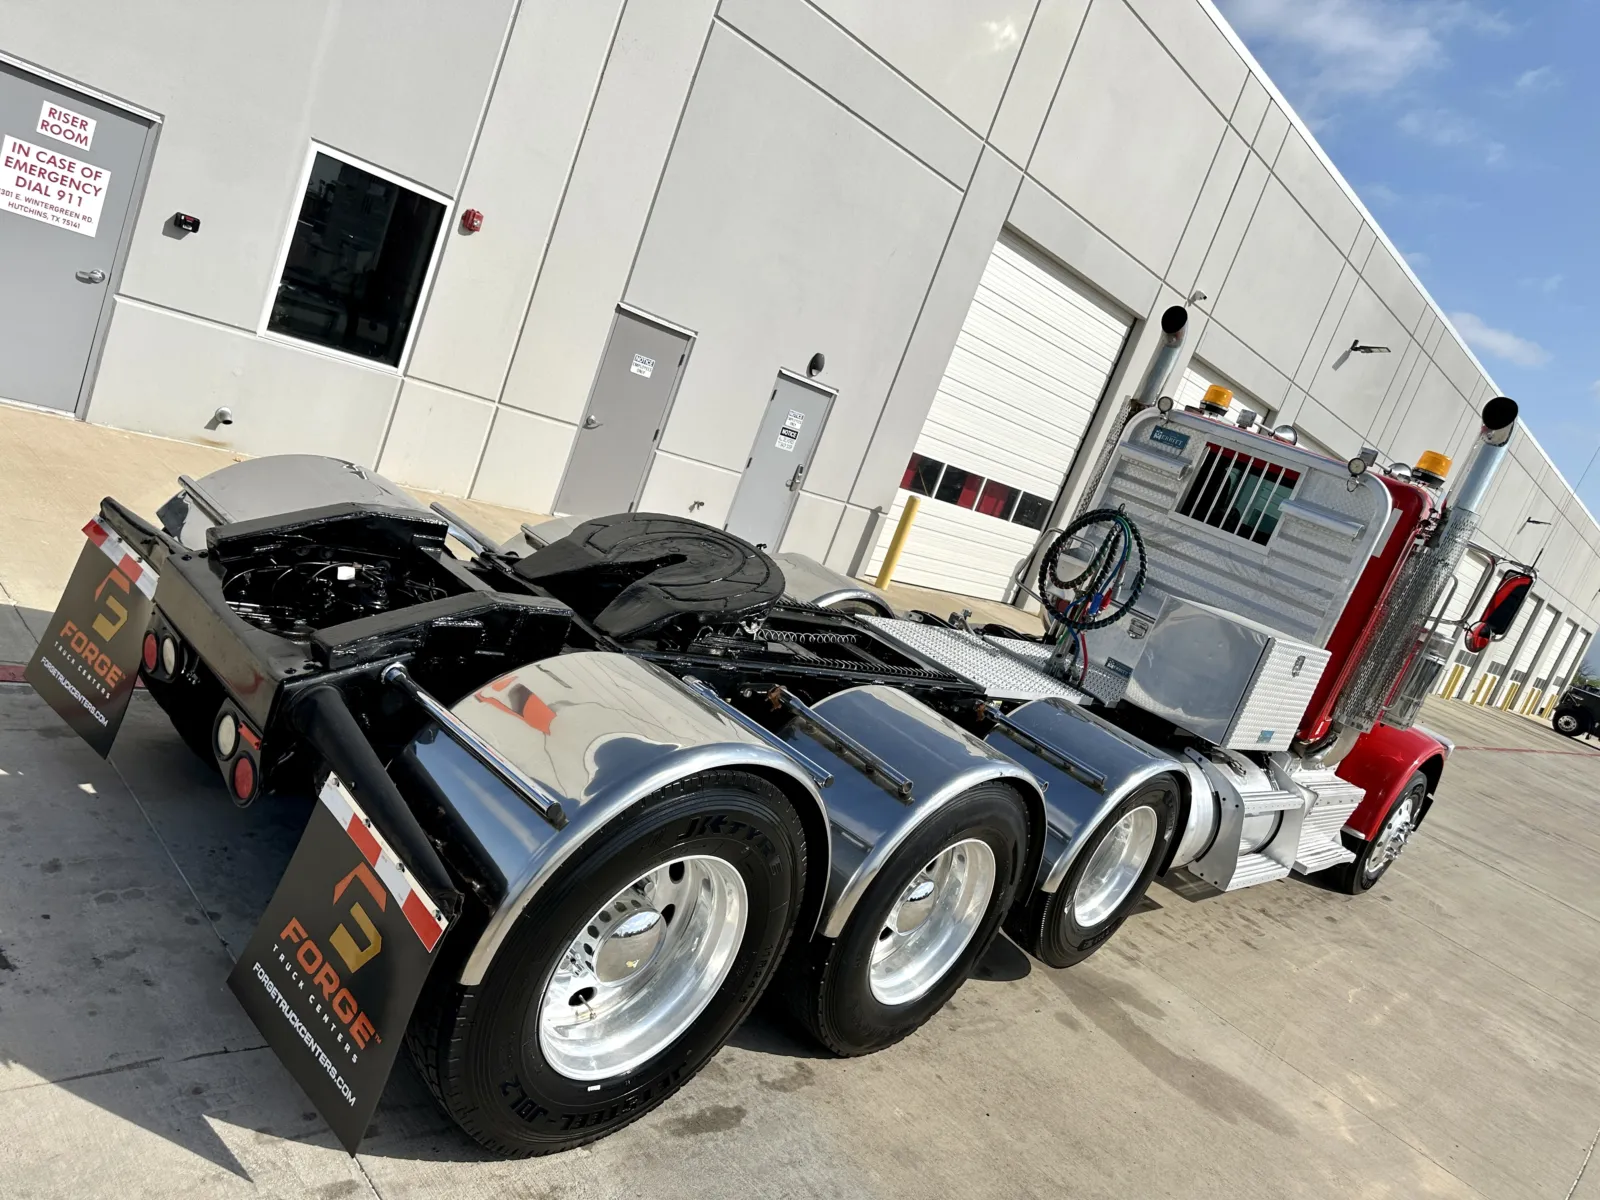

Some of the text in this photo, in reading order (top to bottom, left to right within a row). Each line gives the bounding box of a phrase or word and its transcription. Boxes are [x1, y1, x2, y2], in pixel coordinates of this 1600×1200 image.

[40, 120, 88, 146] ROOM
[48, 107, 88, 131] RISER
[4, 156, 102, 196] EMERGENCY
[12, 142, 102, 181] IN CASE OF
[0, 188, 13, 198] 301
[25, 196, 80, 219] WINTERGREEN
[82, 214, 93, 224] RD.
[15, 176, 83, 207] DIAL 911
[8, 202, 80, 229] HUTCHINS, TX 75141
[54, 641, 111, 699] TRUCK CENTERS
[60, 620, 123, 689] FORGE
[40, 656, 109, 727] FORGETRUCKCENTERS.COM
[272, 944, 357, 1063] TRUCK CENTERS
[280, 917, 375, 1050] FORGE
[253, 961, 356, 1107] FORGETRUCKCENTERS.COM
